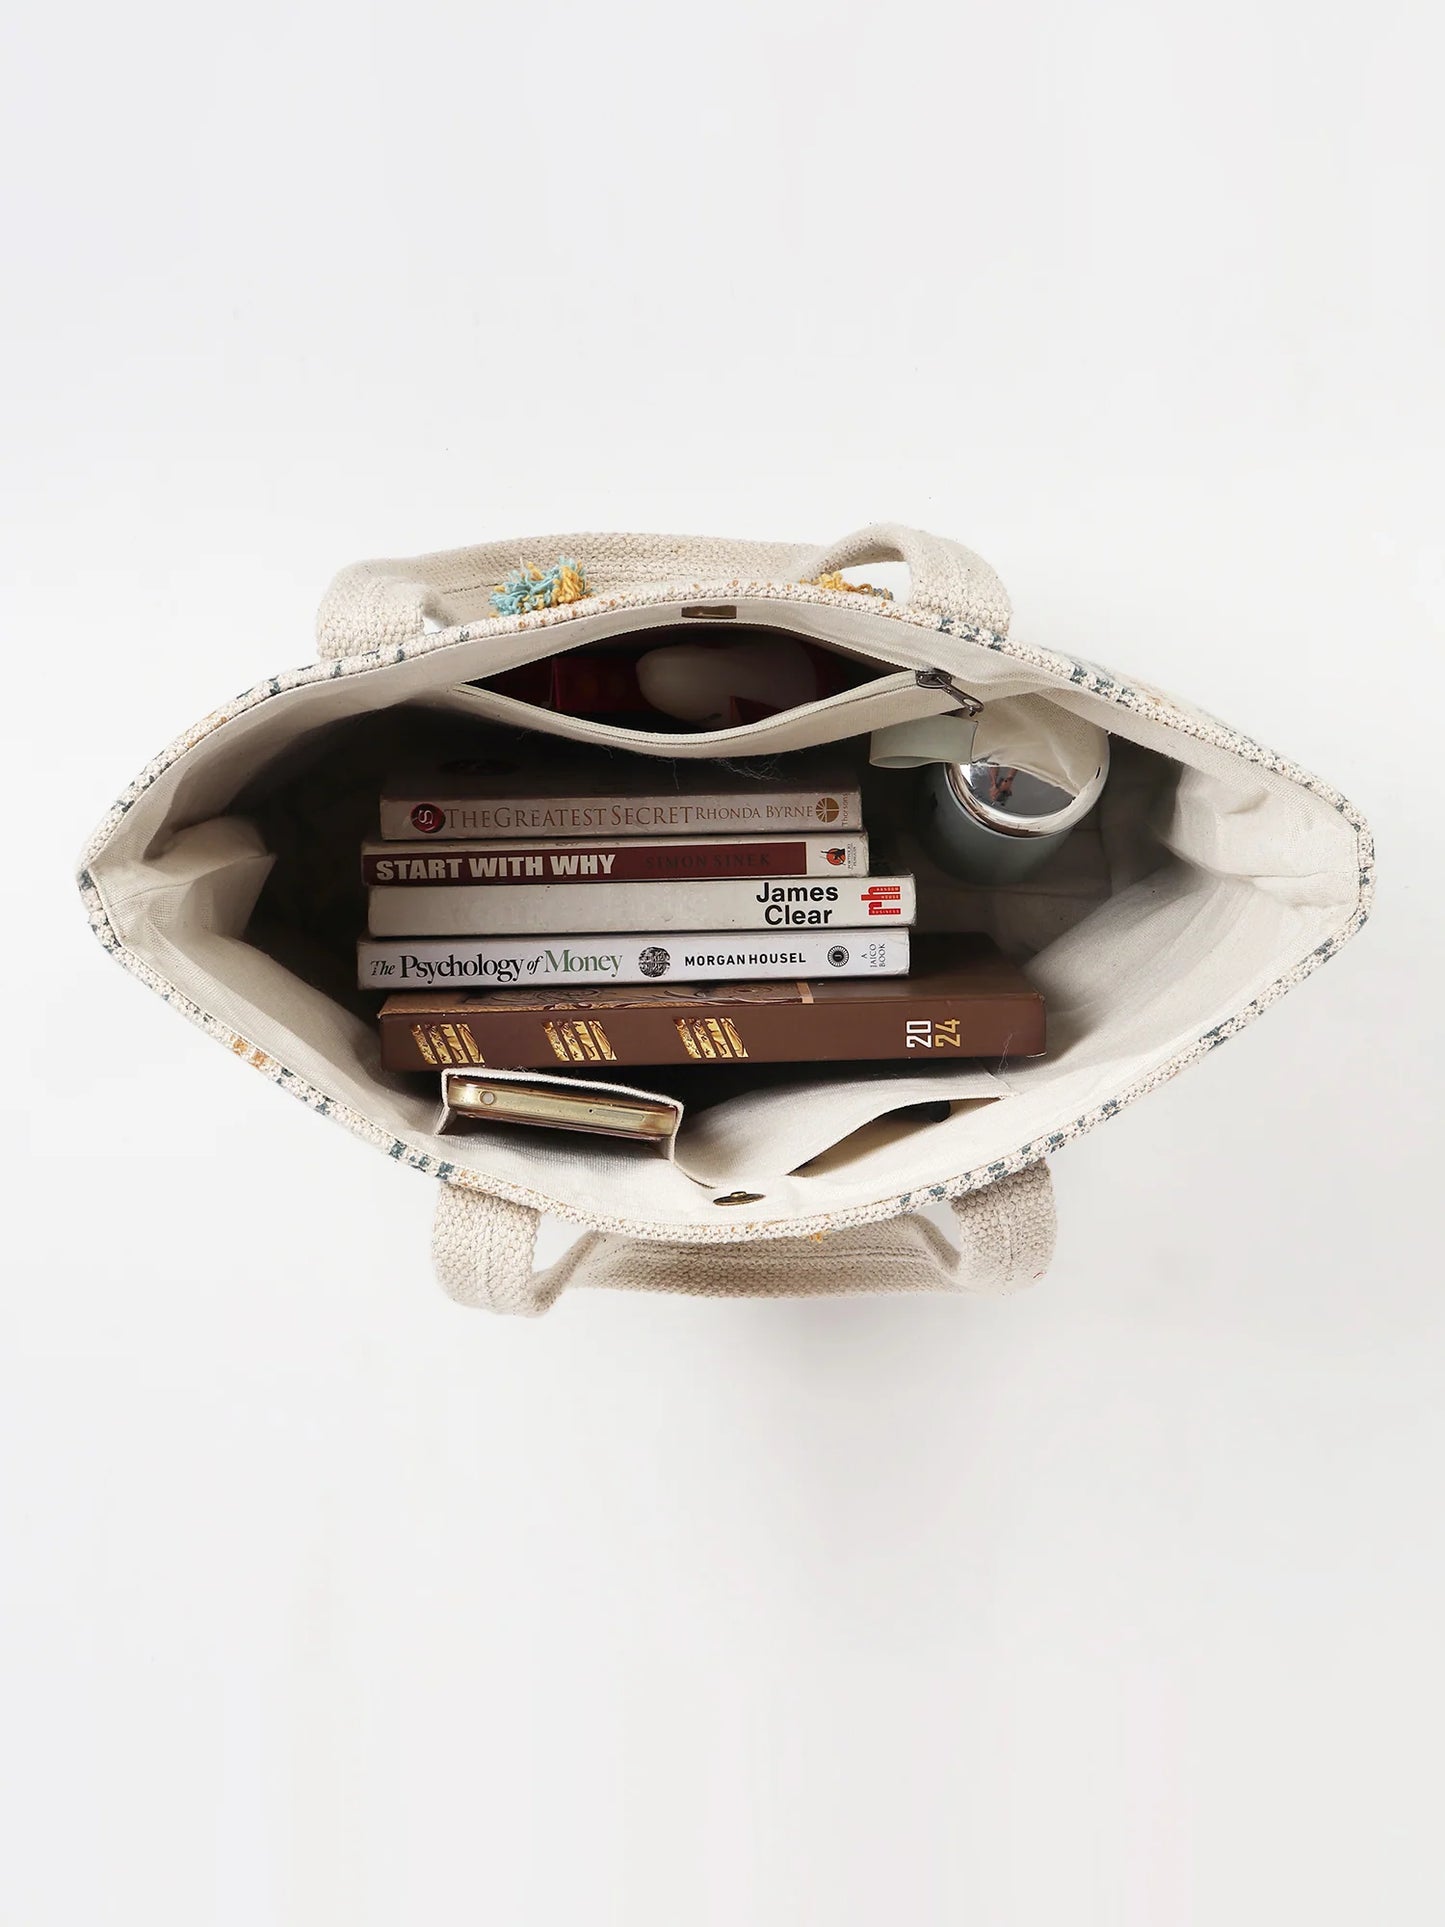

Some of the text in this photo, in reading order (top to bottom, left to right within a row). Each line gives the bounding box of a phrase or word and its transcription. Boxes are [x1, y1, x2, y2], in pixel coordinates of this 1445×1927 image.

[444, 805, 693, 829] THE GREATEST SECRET
[696, 805, 814, 820] RHONDA BYRNE
[376, 854, 616, 881] START WITH WHY
[645, 853, 770, 870] SIMON SINEK
[756, 882, 839, 903] James
[764, 904, 833, 926] Clear
[370, 949, 623, 984] The Psychology of Money
[684, 952, 807, 967] MORGAN HOUSEL
[878, 943, 886, 967] BOOK
[906, 1020, 932, 1048] 20
[934, 1018, 961, 1047] 24
